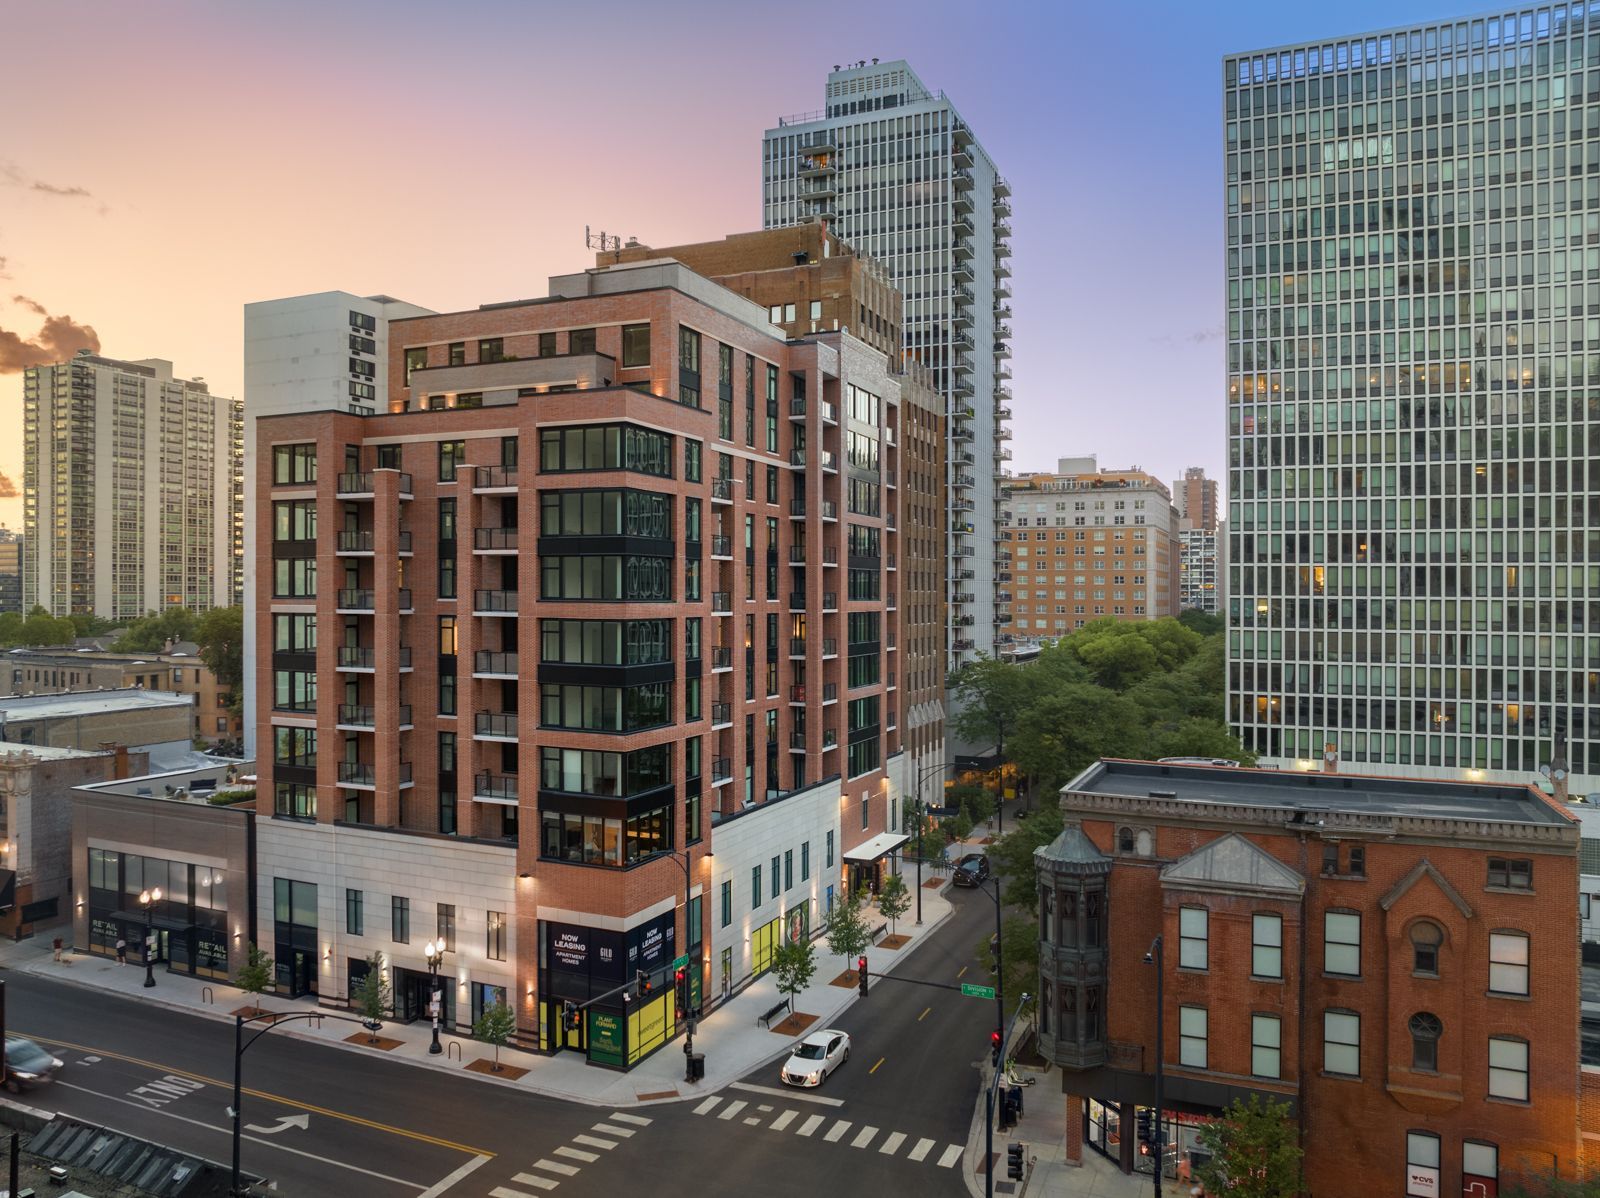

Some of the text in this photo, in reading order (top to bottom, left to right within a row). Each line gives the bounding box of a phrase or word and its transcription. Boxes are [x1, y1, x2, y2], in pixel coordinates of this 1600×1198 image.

[561, 933, 578, 942] NOW
[646, 927, 658, 939] NOW
[554, 940, 586, 951] LEASING
[642, 932, 662, 949] LEASING
[556, 951, 586, 960] APARTMENT
[562, 958, 580, 966] HOMES
[125, 1074, 206, 1108] ONLY
